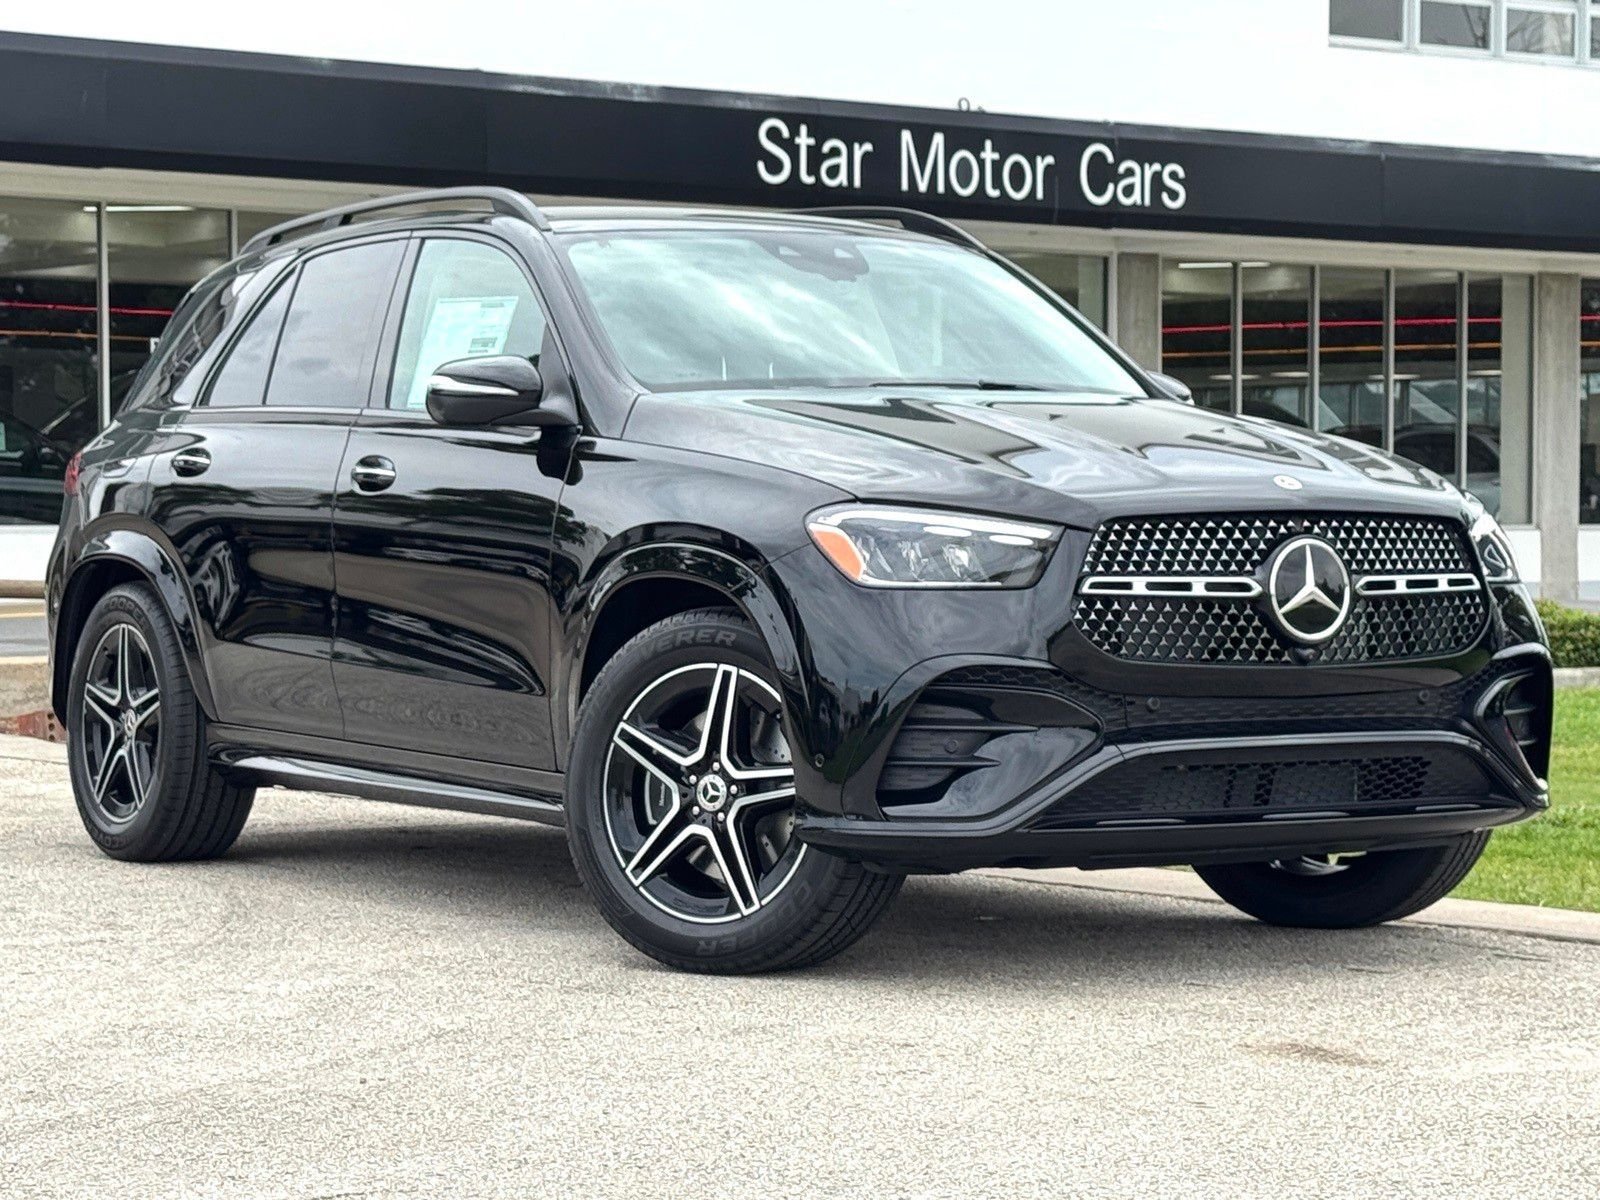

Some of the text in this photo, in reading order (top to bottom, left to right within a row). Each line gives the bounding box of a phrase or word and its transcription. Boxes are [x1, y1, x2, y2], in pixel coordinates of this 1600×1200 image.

[757, 118, 1187, 210] Star Motor Cars
